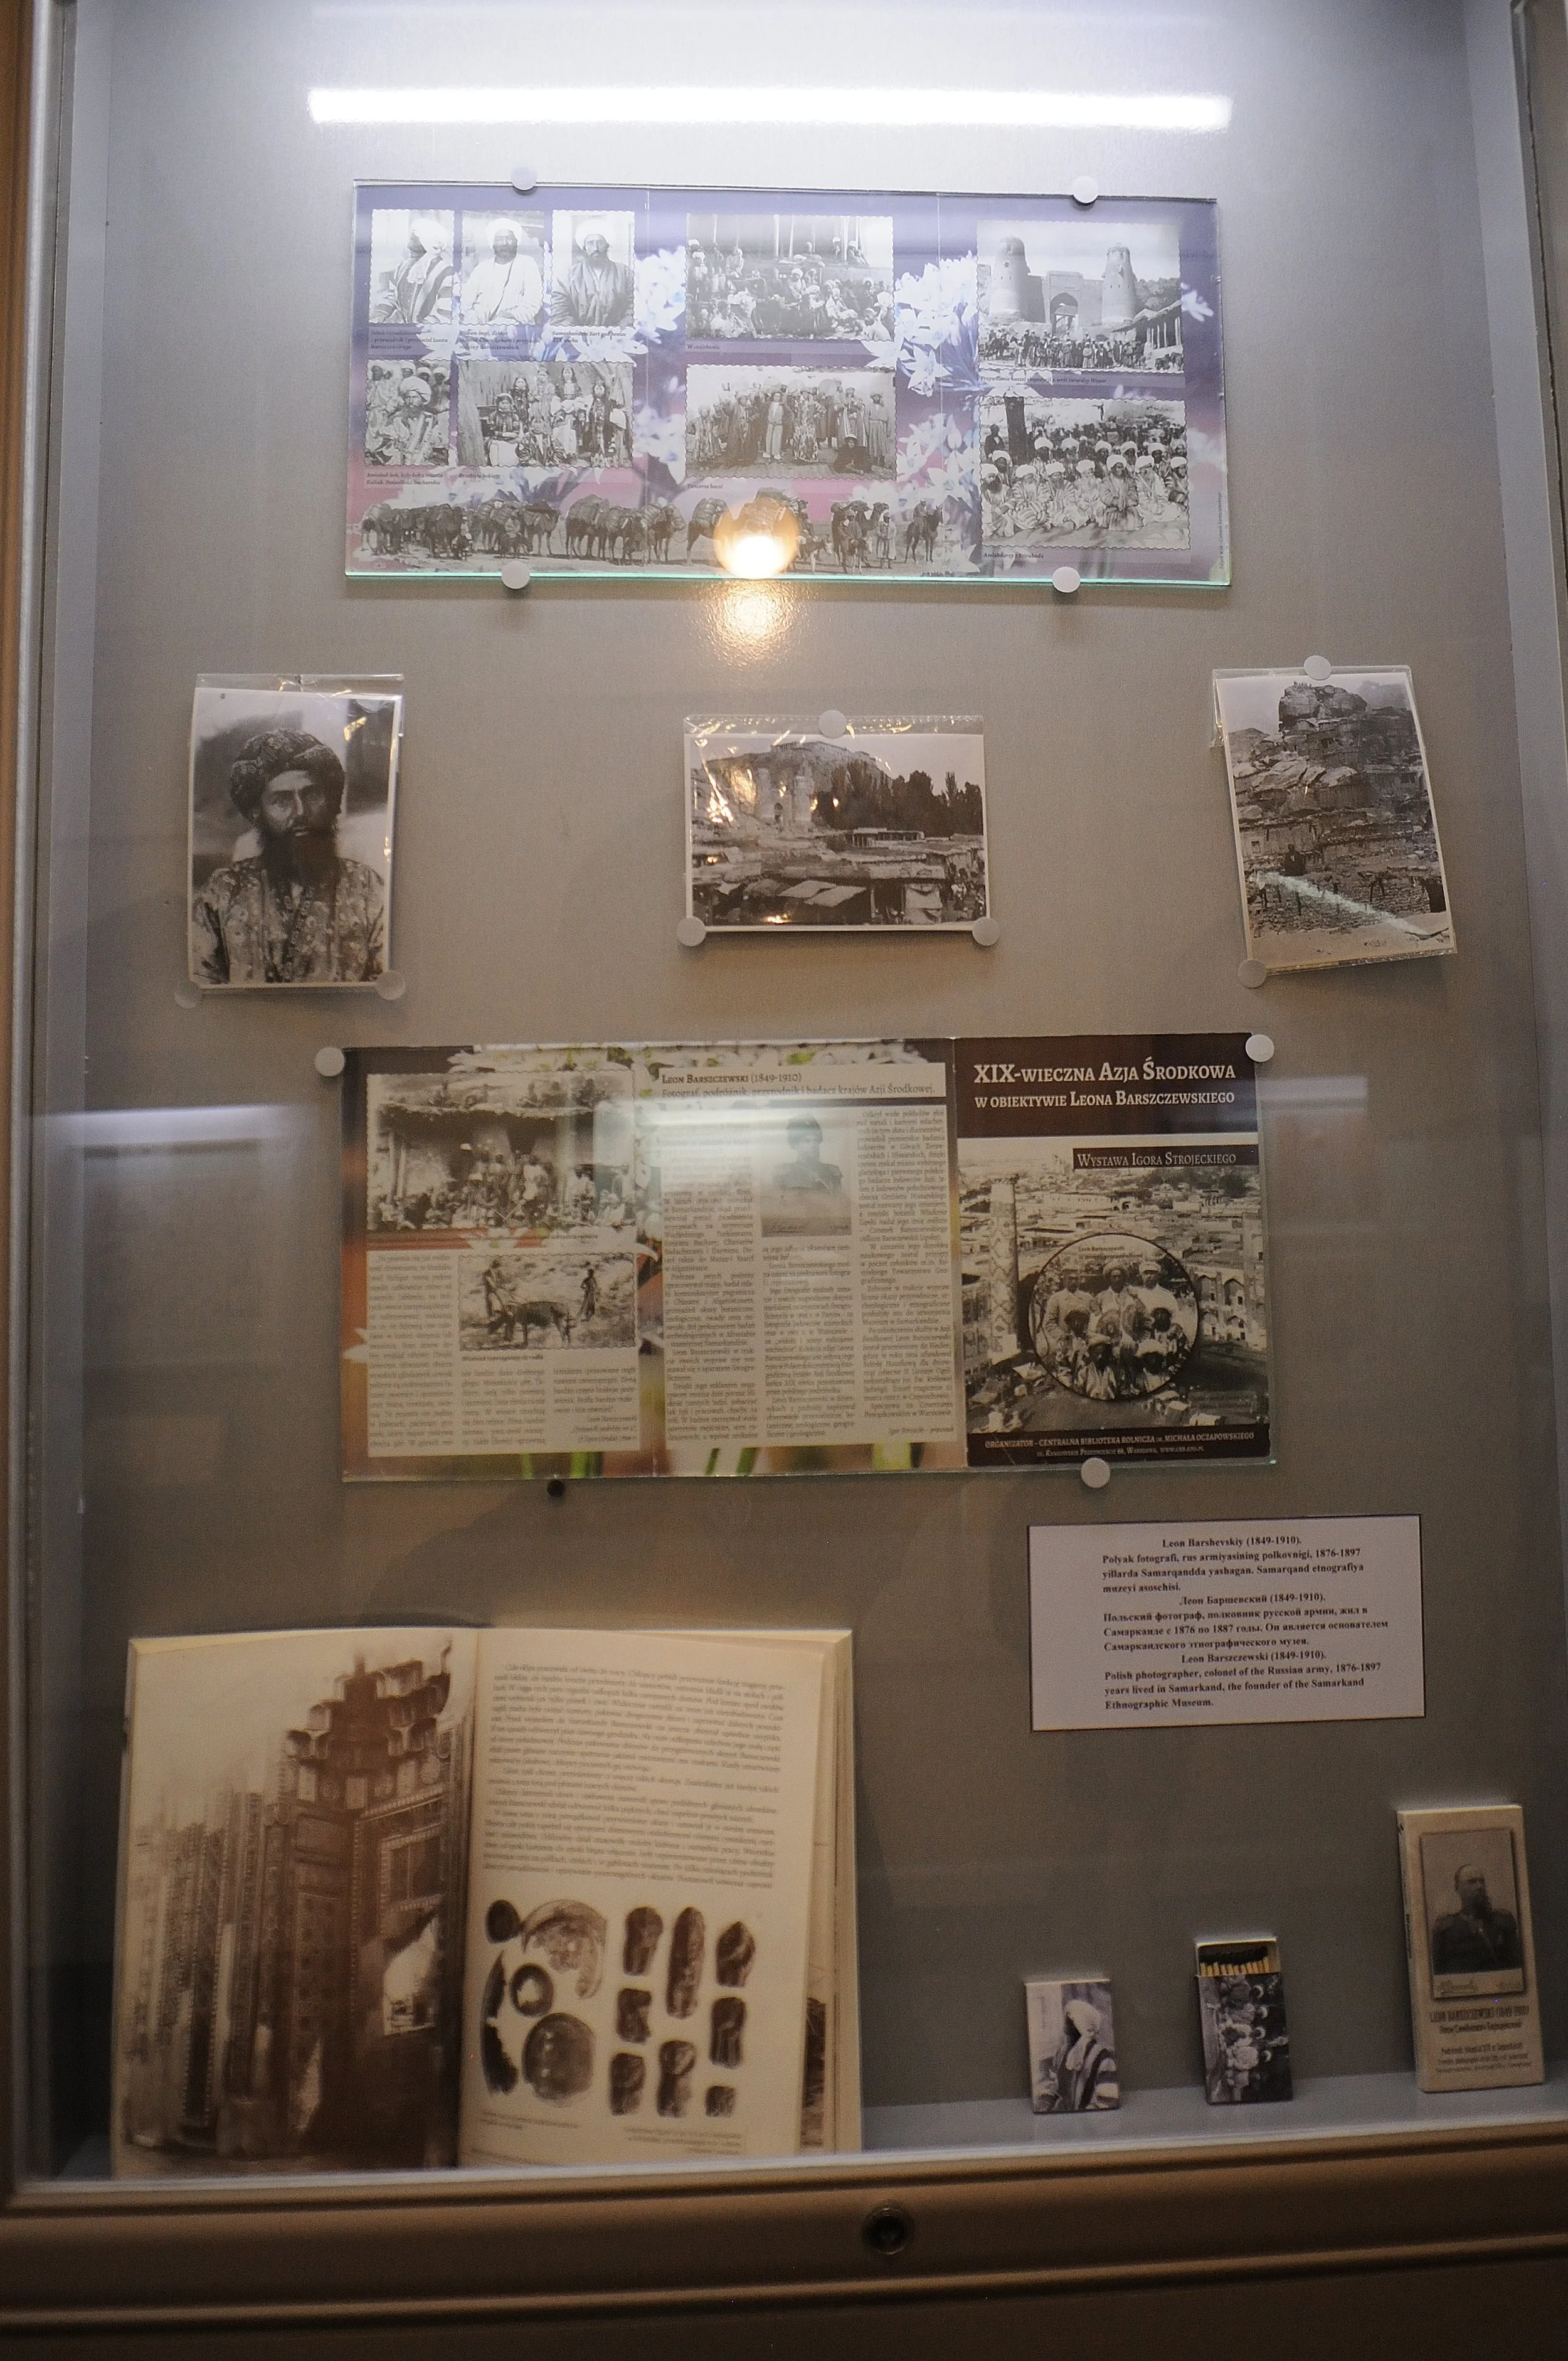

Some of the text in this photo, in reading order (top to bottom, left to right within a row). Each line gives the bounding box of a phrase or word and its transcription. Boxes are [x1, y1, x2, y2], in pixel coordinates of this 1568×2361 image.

[1098, 1062, 1139, 1083] AZJA
[1143, 1056, 1236, 1080] ŚRODKOWA
[751, 1073, 802, 1084] (1849-1910)
[838, 1085, 867, 1096] krajów
[869, 1085, 886, 1095] Azji
[887, 1083, 935, 1095] Środkowej.
[990, 1096, 1067, 1108] OBIEKTYWIE
[1069, 1091, 1113, 1106] LEONA
[1115, 1090, 1235, 1106] BARSZCZEWSKIEGO
[1165, 1152, 1236, 1165] STROJECKIEGO
[985, 1440, 1034, 1448] ORGANIZATOR
[1039, 1438, 1079, 1446] CENTRALNA
[1080, 1436, 1120, 1445] BIBLIOTEKA
[1121, 1435, 1155, 1443] ROLNICZA
[1196, 1432, 1254, 1441] OCZAPOWSKIEGO
[1163, 1536, 1301, 1549] Leon Barshevskiy (1849-1910).
[1103, 1554, 1134, 1566] Polyak
[1137, 1553, 1179, 1564] fotografi,
[1200, 1551, 1259, 1563] armiyasining
[1316, 1548, 1360, 1557] 1876-1897
[1103, 1563, 1364, 1580] yillarda Samarqandda yashagan. Samarqand etnografiya
[1139, 1583, 1180, 1592] asoschisi.
[1179, 1596, 1203, 1605] Леон
[1270, 1593, 1325, 1605] (1849-1910).
[1104, 1612, 1152, 1621] Польский
[1155, 1610, 1205, 1622] фотограф,
[1263, 1608, 1301, 1619] русской
[1304, 1609, 1337, 1618] армии,
[1104, 1626, 1163, 1638] Самарканде
[1175, 1625, 1195, 1634] 1876
[1213, 1624, 1233, 1633] 1887
[1265, 1623, 1279, 1631] Он
[1104, 1637, 1308, 1653] Самаркандского этнографического музея.
[1182, 1654, 1204, 1663] Leon
[1271, 1651, 1326, 1663] (1849-1910).
[1105, 1663, 1380, 1681] Polish photographer, colonel of the Russian army, 1876-1897
[1105, 1678, 1364, 1697] years lived in Samarkand, the founder of the Samarkand
[1105, 1697, 1214, 1712] Ethnographic Museum.
